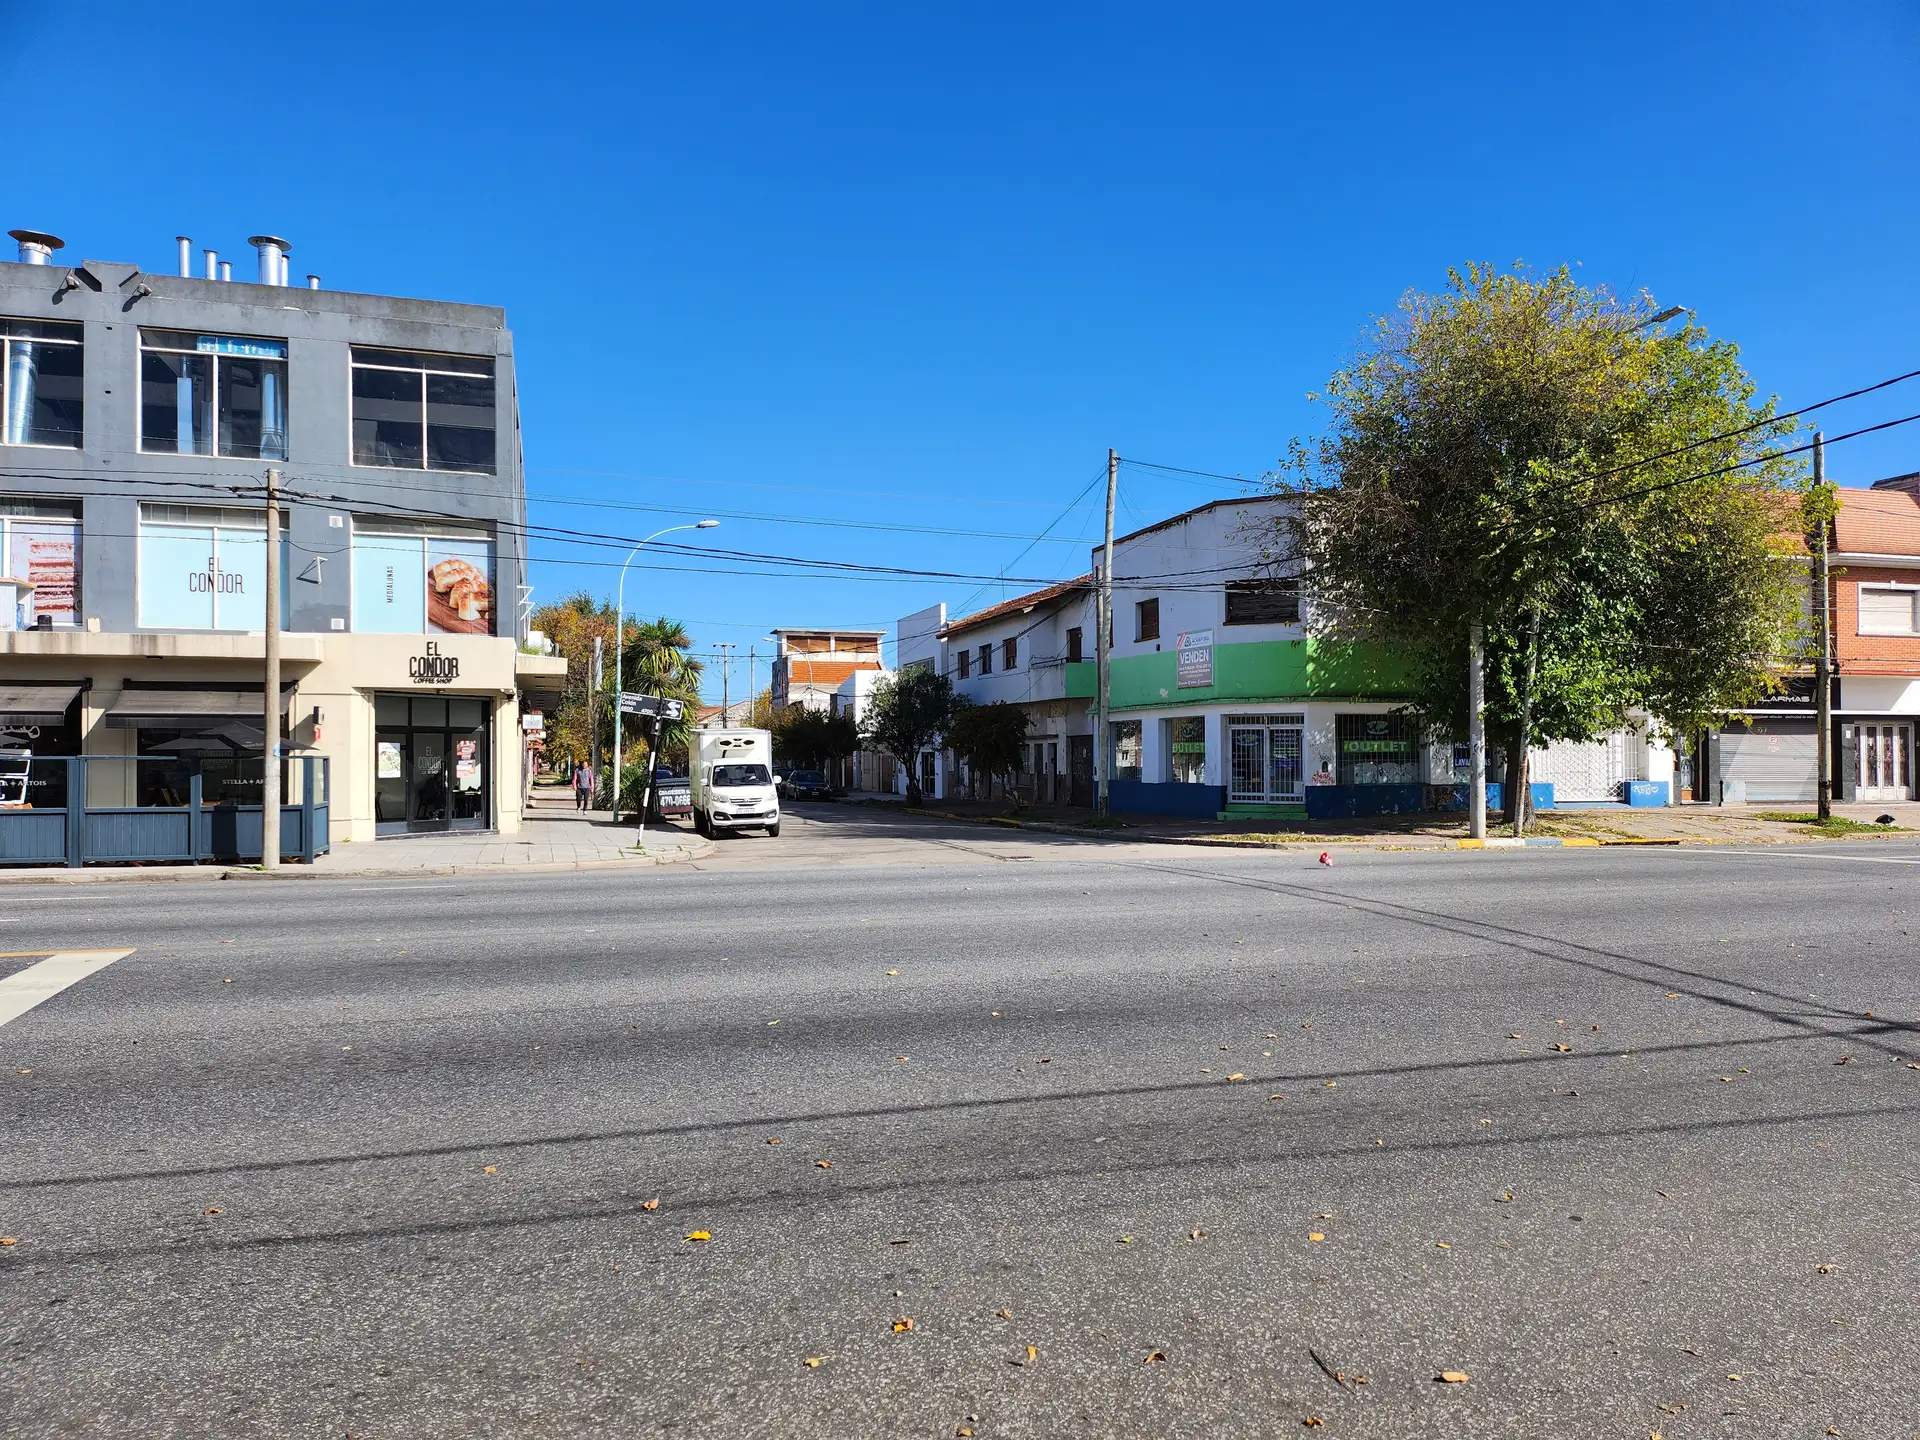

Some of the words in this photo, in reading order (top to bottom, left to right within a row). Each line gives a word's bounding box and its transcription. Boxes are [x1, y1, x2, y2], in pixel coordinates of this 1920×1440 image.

[208, 557, 223, 572] EL
[189, 572, 244, 594] CONDOR
[386, 565, 394, 604] MEDIALUNAS
[426, 641, 442, 656] EL
[1180, 649, 1209, 664] VENDEN
[409, 656, 460, 677] CONDOR
[622, 693, 643, 702] Avenida
[1756, 695, 1810, 703] LARMAS
[1172, 742, 1205, 753] OUTLET
[1349, 741, 1407, 752] OUTLET
